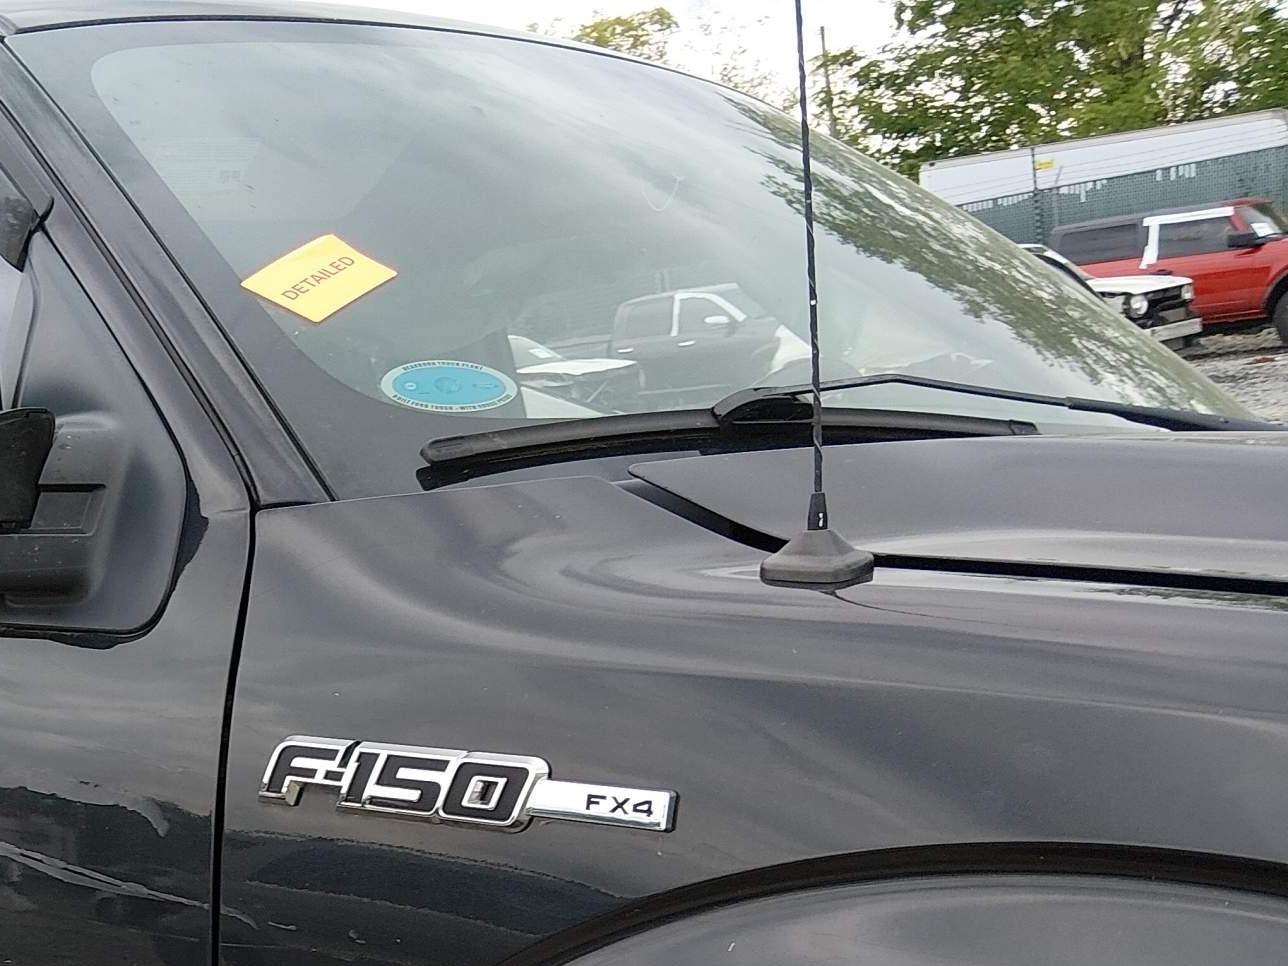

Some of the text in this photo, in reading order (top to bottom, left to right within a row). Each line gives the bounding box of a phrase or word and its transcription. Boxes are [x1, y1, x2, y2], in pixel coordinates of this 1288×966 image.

[280, 255, 356, 302] DETAILED
[262, 738, 654, 828] F-150 FX4
